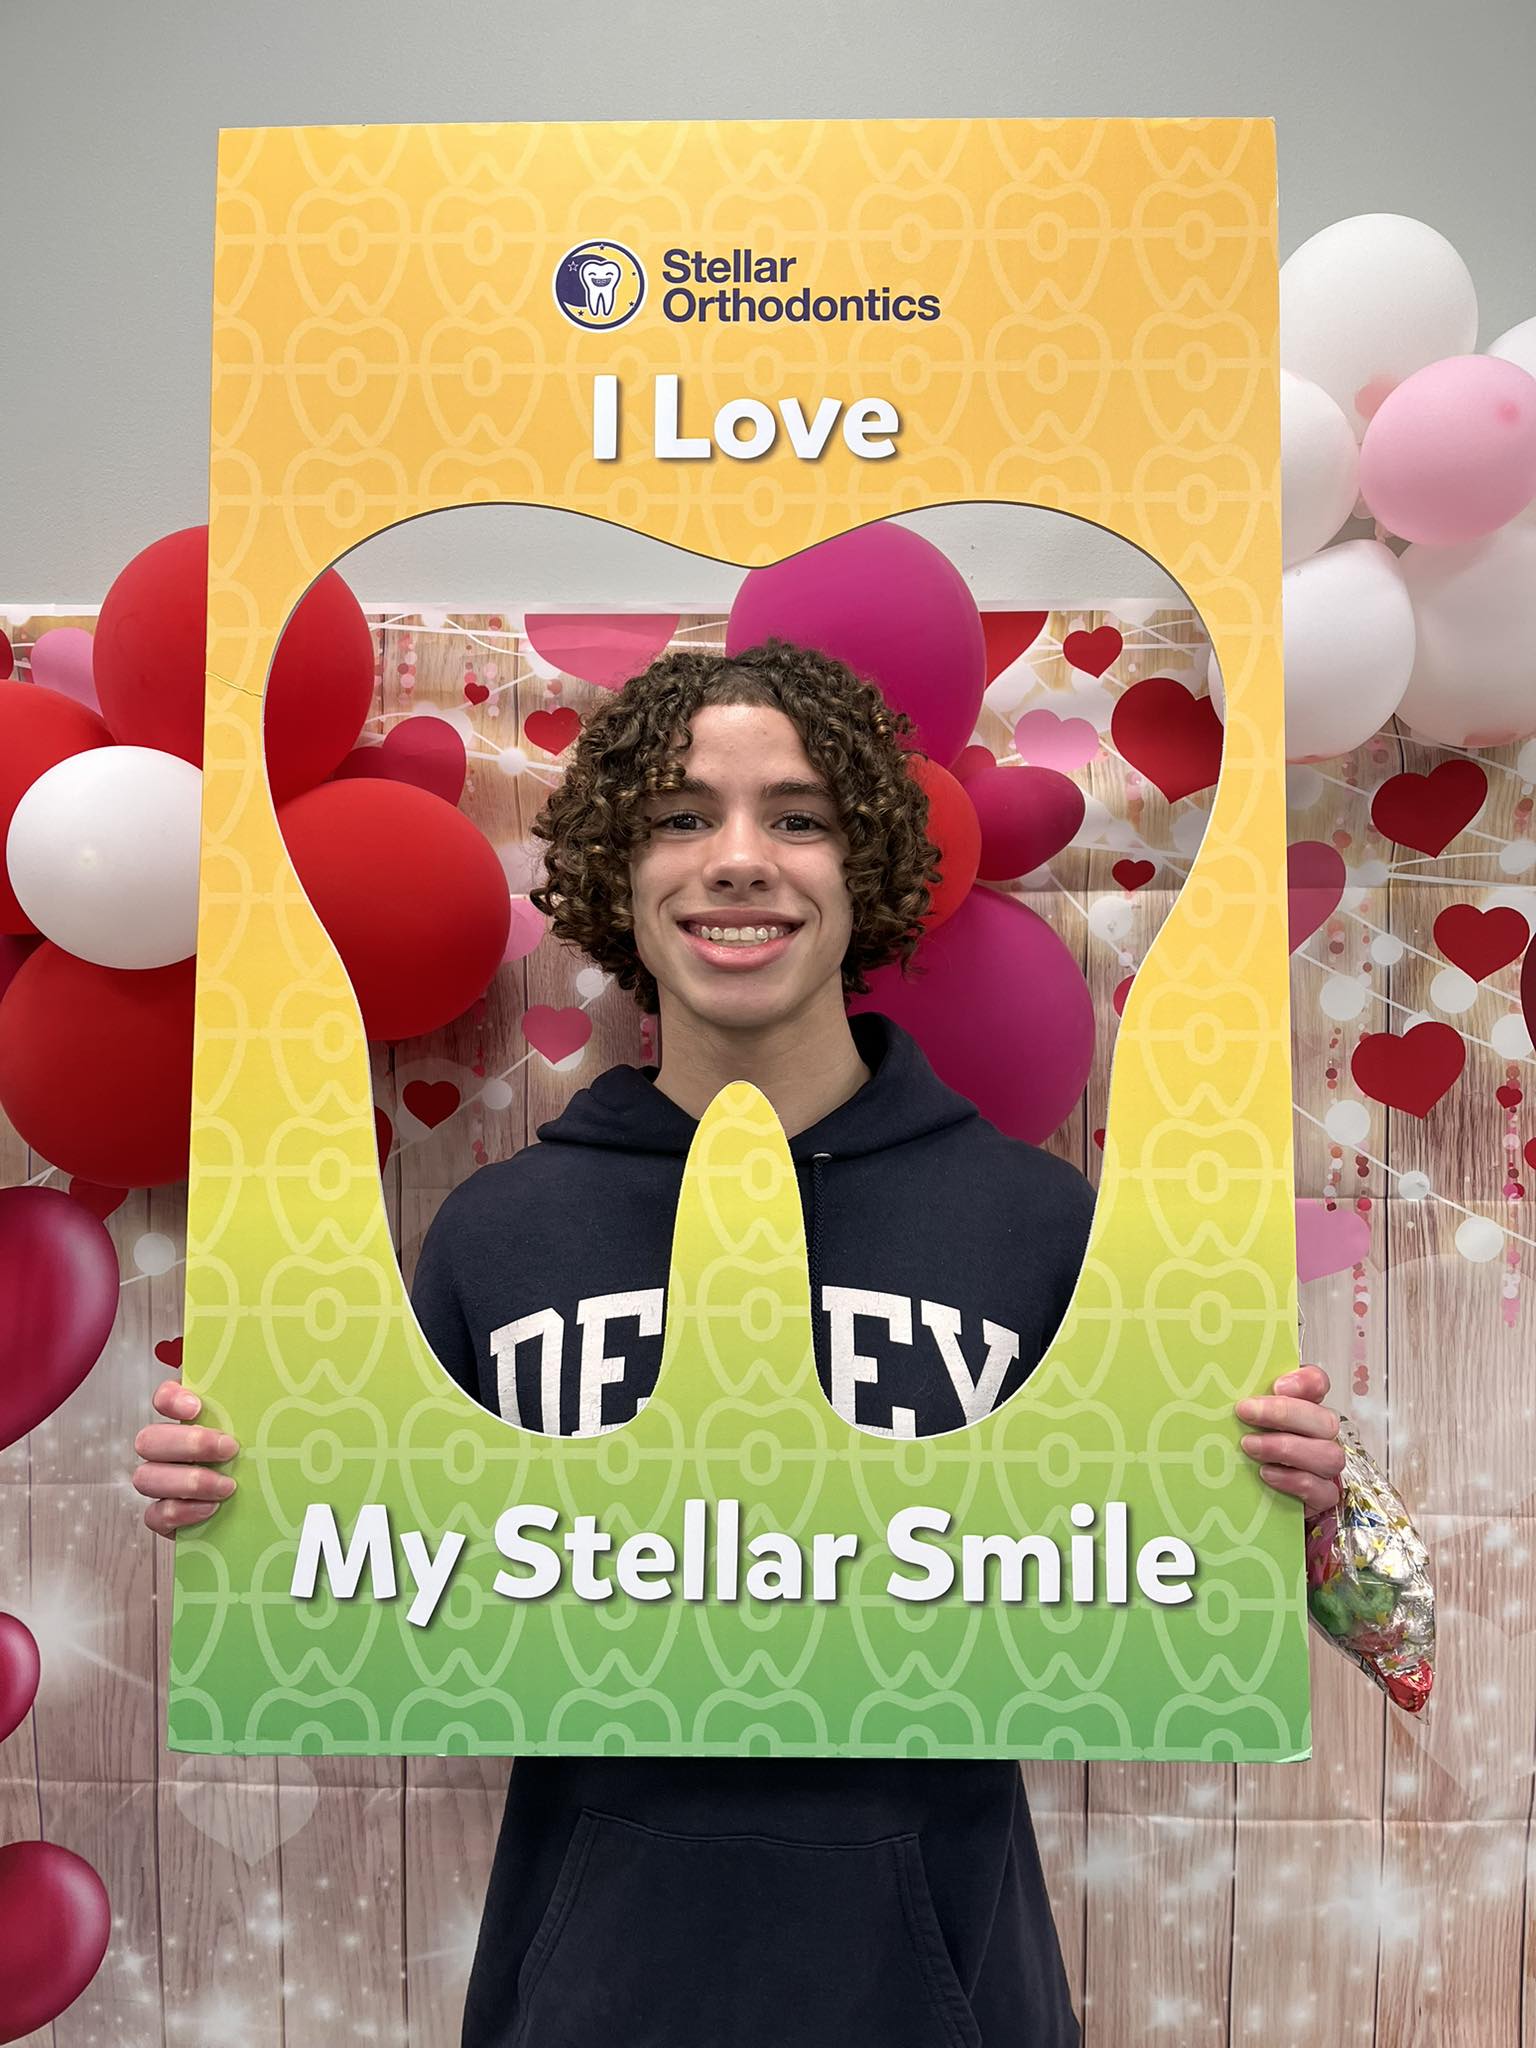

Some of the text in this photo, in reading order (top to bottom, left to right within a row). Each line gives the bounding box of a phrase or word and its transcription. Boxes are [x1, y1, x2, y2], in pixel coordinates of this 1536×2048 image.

[662, 249, 797, 283] Stellar
[662, 286, 941, 322] Orthodontics
[593, 373, 899, 460] I Love
[290, 1499, 1196, 1627] My Stellar Smile
